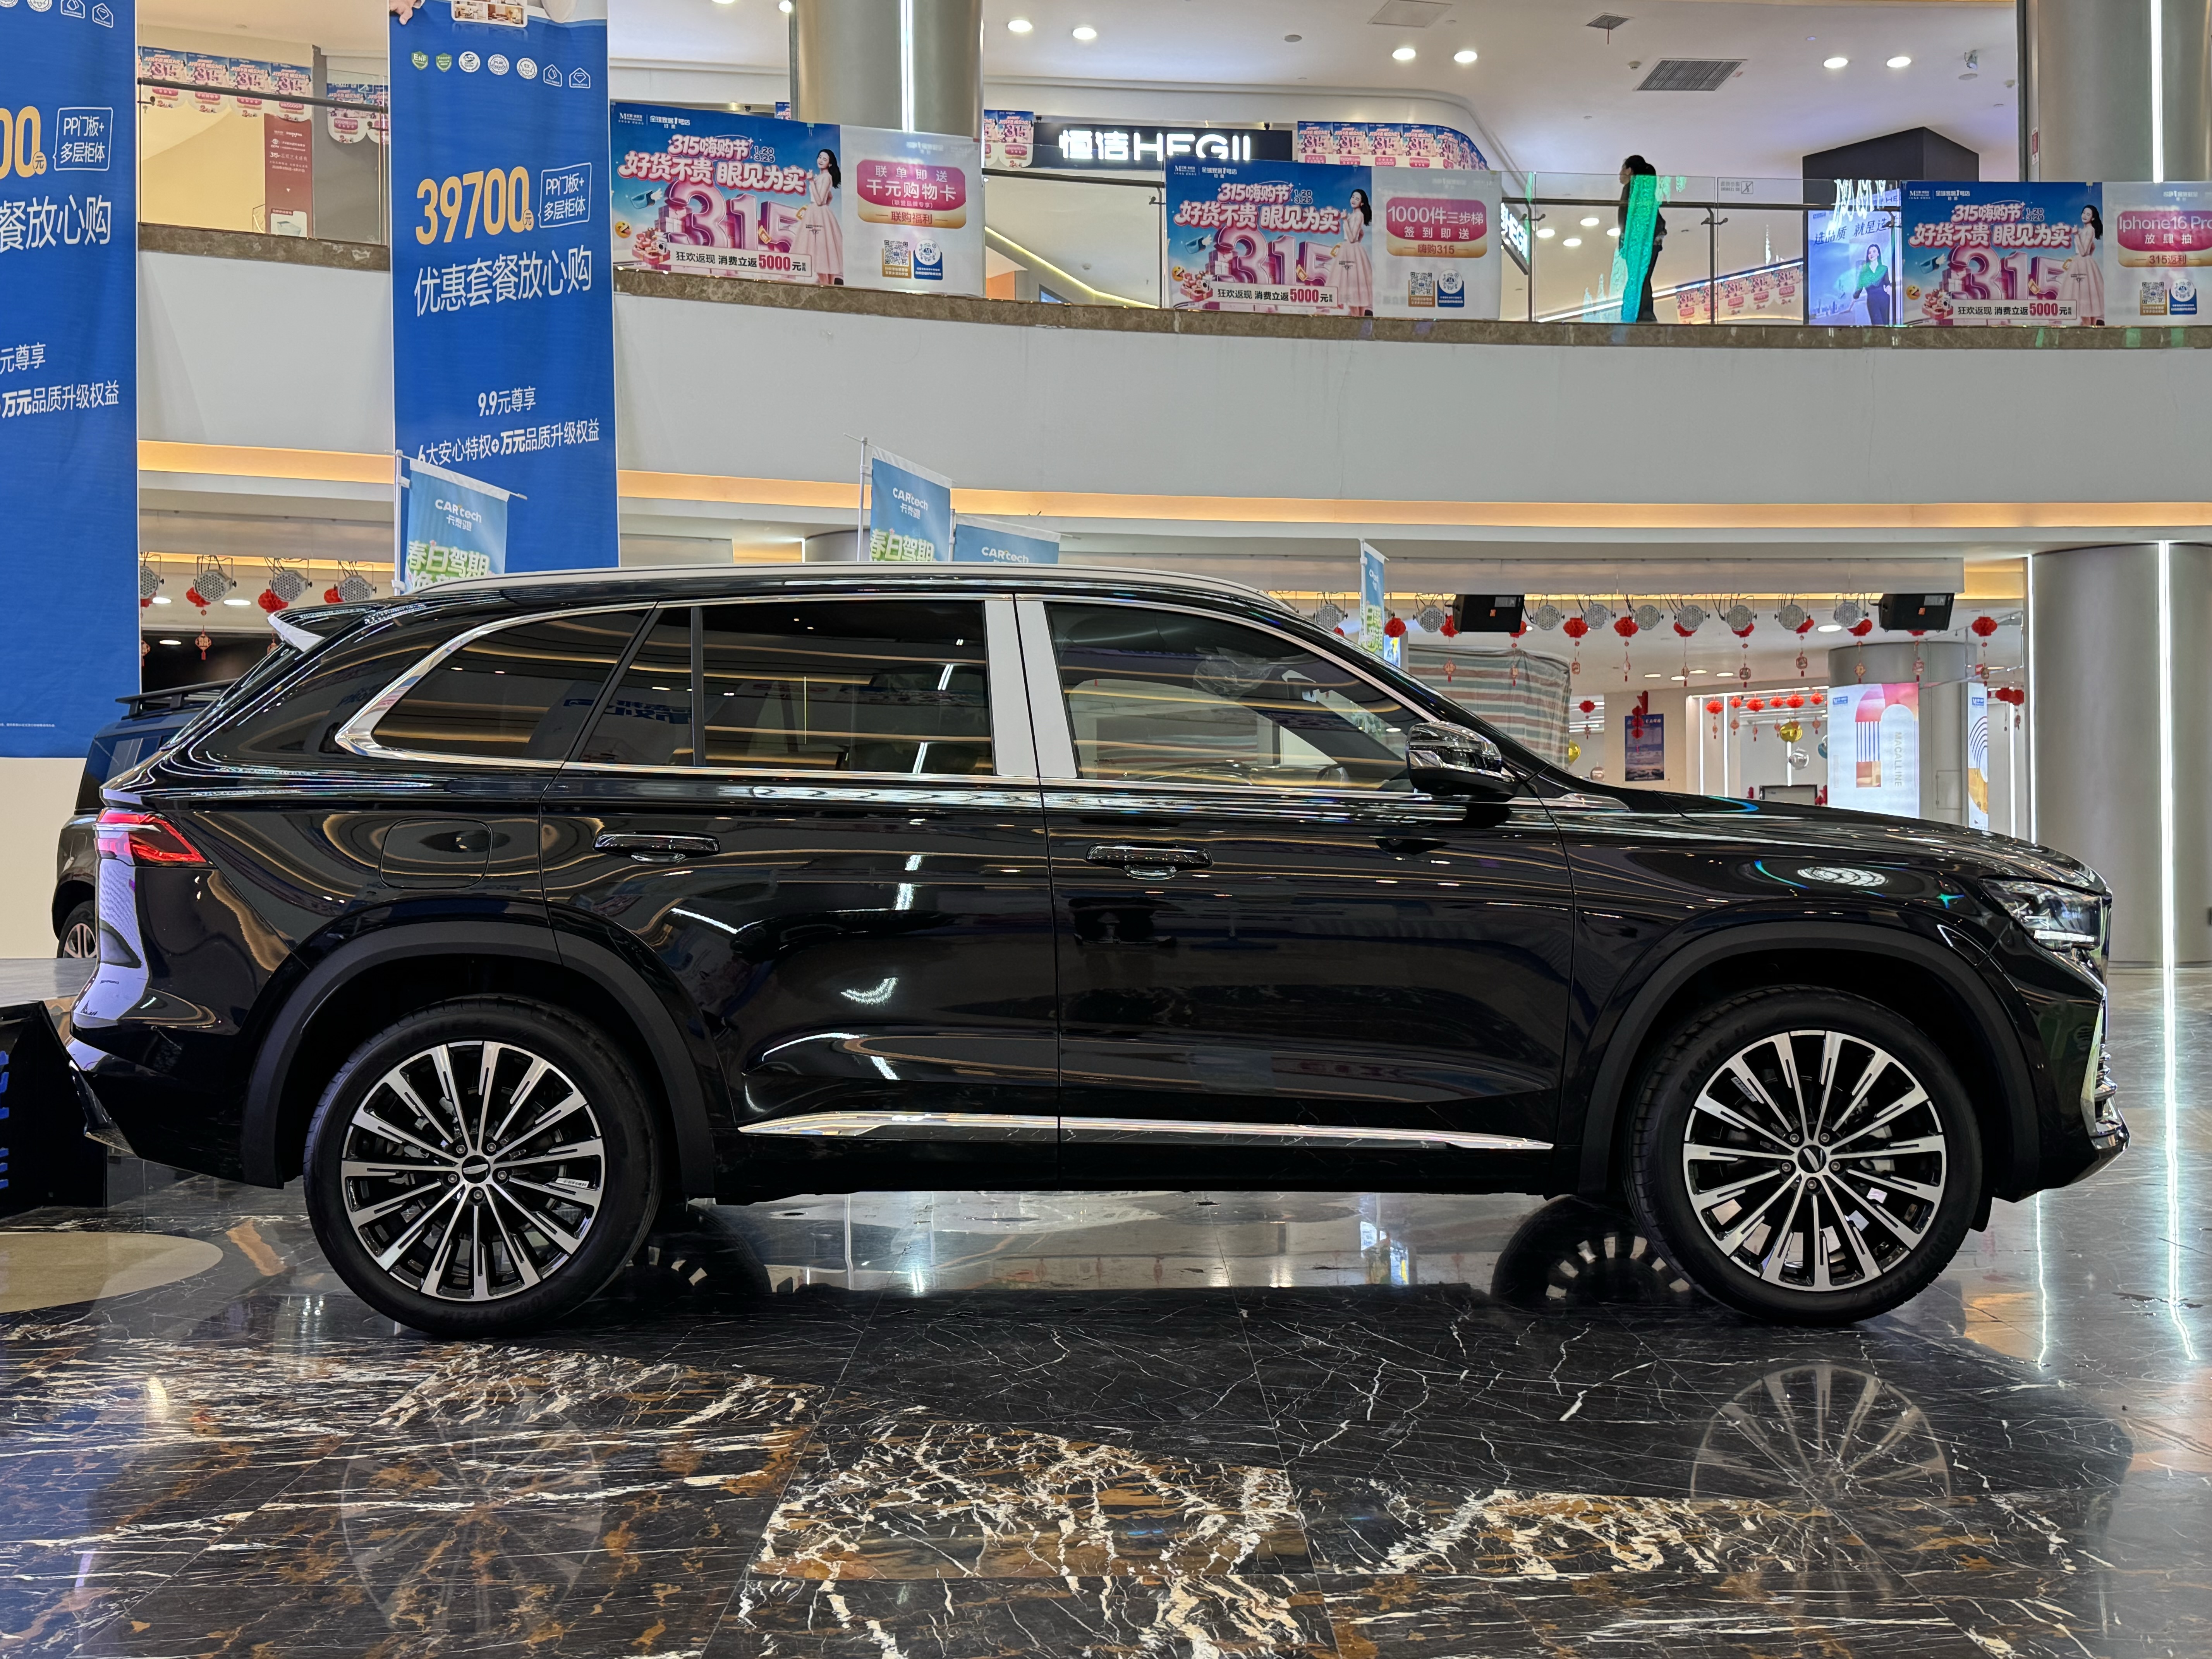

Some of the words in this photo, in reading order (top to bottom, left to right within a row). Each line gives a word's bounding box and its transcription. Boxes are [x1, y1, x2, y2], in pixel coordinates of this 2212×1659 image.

[63, 116, 105, 137] PP门板+
[61, 143, 105, 164] 多层柜体
[669, 134, 750, 160] 315嗨购节
[754, 147, 775, 155] 1.20
[754, 155, 775, 163] 3.29
[619, 151, 713, 185] 好货不贵
[716, 161, 807, 195] 眼见为实
[546, 173, 584, 196] PP门板+
[1218, 183, 1290, 204] 315嗨购节
[544, 196, 586, 221] 多层柜体
[1294, 196, 1313, 205] 3.29
[891, 211, 933, 224] 联购福利
[1174, 201, 1258, 229] 好货不贵
[1260, 205, 1341, 234] 眼见为实
[1387, 206, 1484, 225] 1000件三步梯
[1951, 203, 2022, 223] 315嗨购节
[0, 194, 111, 254] 餐放心购
[1404, 226, 1470, 240] 签到即送
[2119, 215, 2187, 234] Iphone16
[1909, 223, 1990, 247] 好货不贵
[1993, 224, 2072, 248] 眼见为实
[2145, 234, 2192, 245] 放肆抽
[676, 251, 715, 264] 狂欢返现
[1417, 244, 1455, 255] 嗨购315
[2149, 254, 2187, 265] 315返利
[414, 245, 592, 317] 优惠套餐放心购
[1217, 288, 1252, 299] 狂欢返现
[1958, 305, 1992, 315] 狂欢返现
[0, 342, 46, 374] 元尊享
[2, 380, 119, 419] 万元品质升级权益
[478, 386, 536, 417] 9.9元尊享
[893, 487, 929, 511] CARtech
[435, 499, 482, 523] CARtech
[871, 529, 934, 562] 春日驾期
[407, 540, 490, 577] 春日驾期
